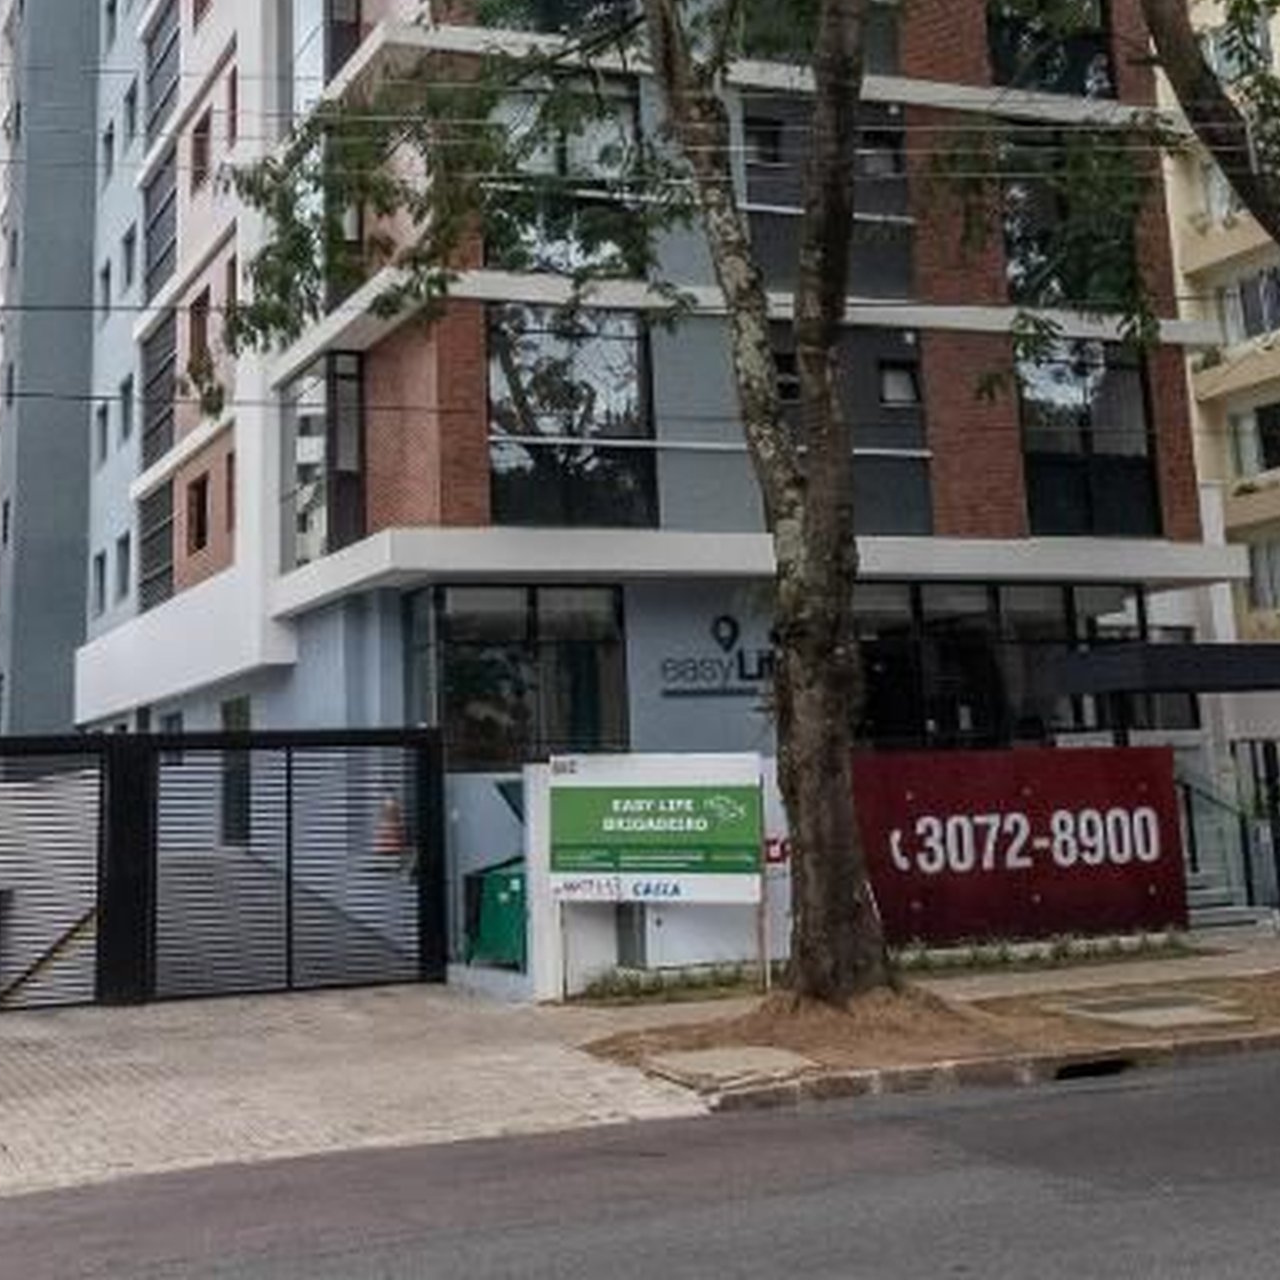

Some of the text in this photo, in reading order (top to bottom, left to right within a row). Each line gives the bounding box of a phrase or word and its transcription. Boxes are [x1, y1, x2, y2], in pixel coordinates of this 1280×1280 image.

[612, 799, 694, 812] EASY LIFE
[602, 818, 708, 832] BRIGADEIRO
[915, 806, 1161, 872] 3072-8900
